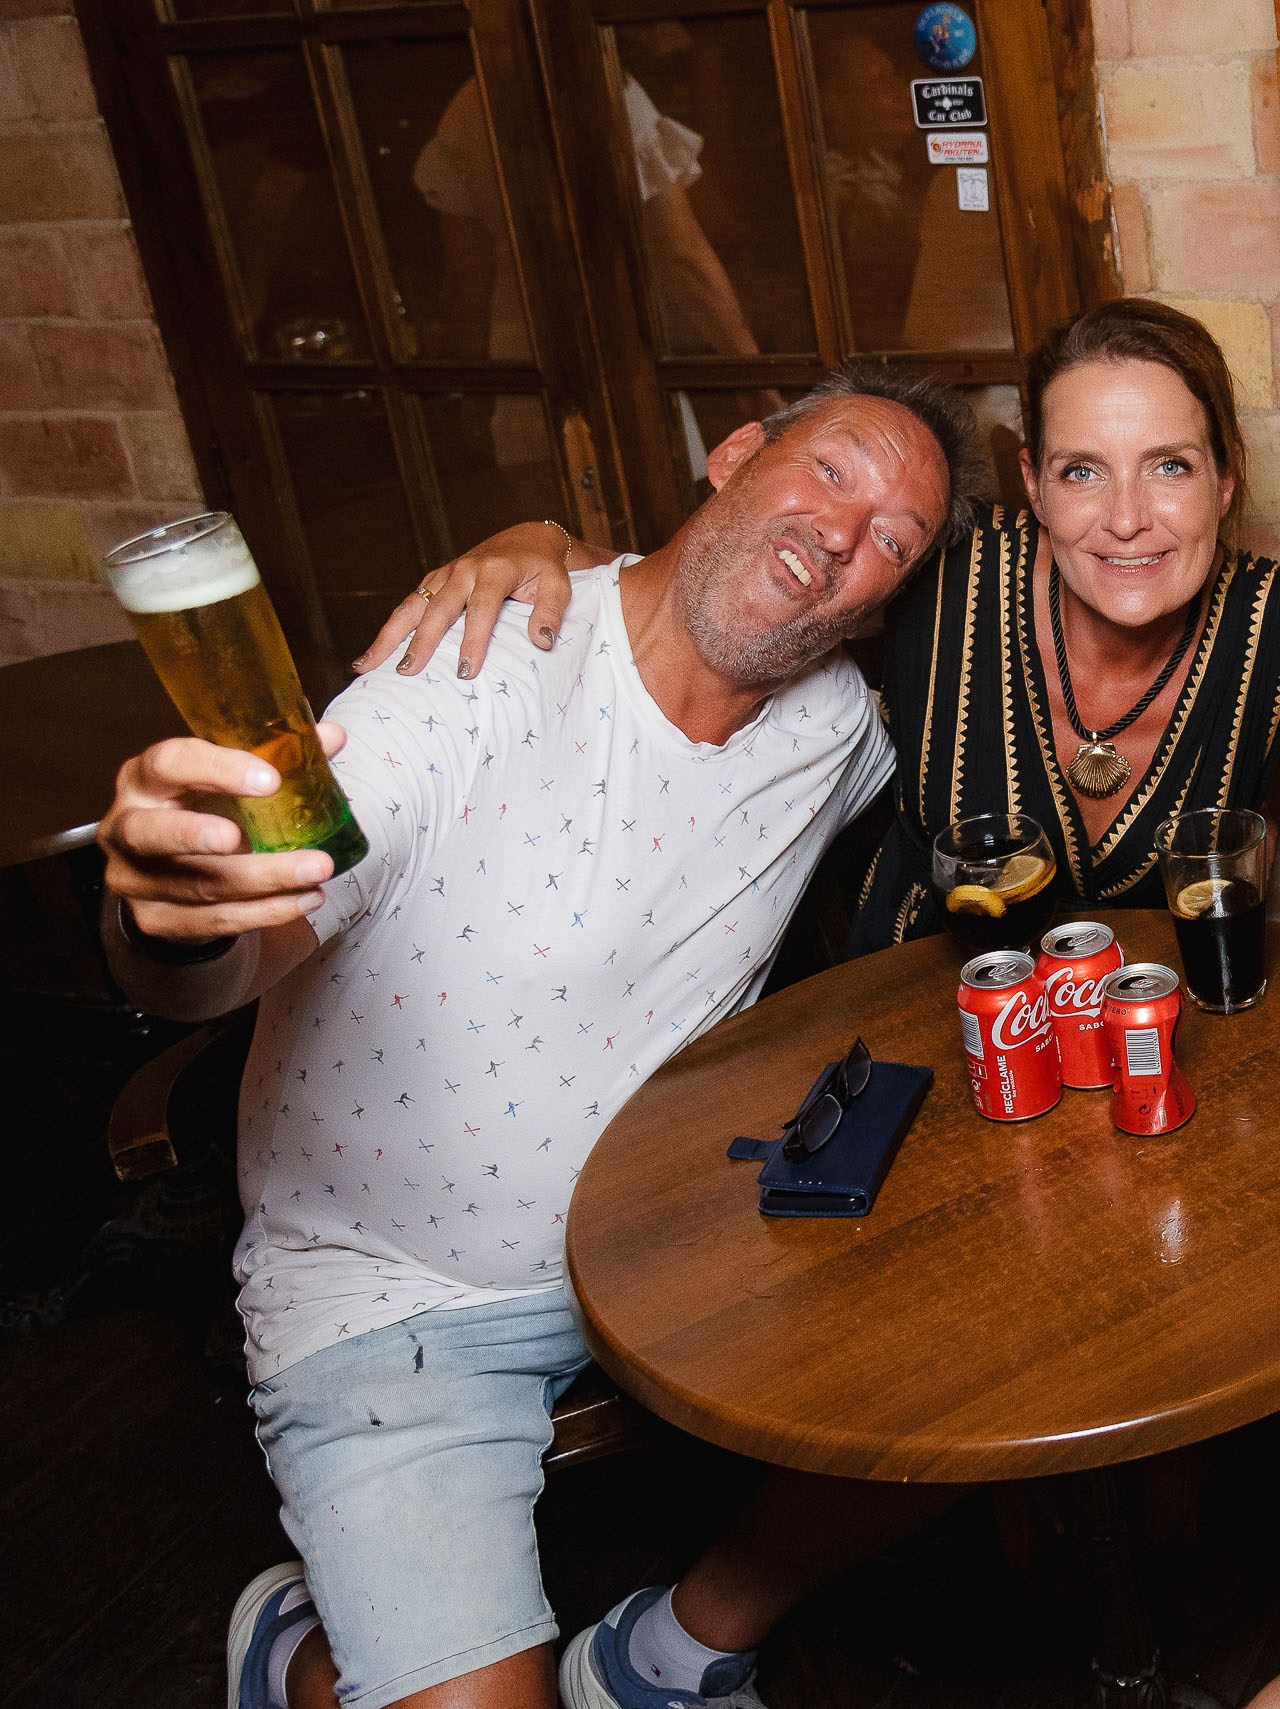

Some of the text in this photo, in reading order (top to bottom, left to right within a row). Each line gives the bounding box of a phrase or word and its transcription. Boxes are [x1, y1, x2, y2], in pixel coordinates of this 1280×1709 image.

[922, 83, 974, 98] Cardinals
[928, 109, 972, 122] Car Club
[997, 1055, 1014, 1114] RECÍCLAME
